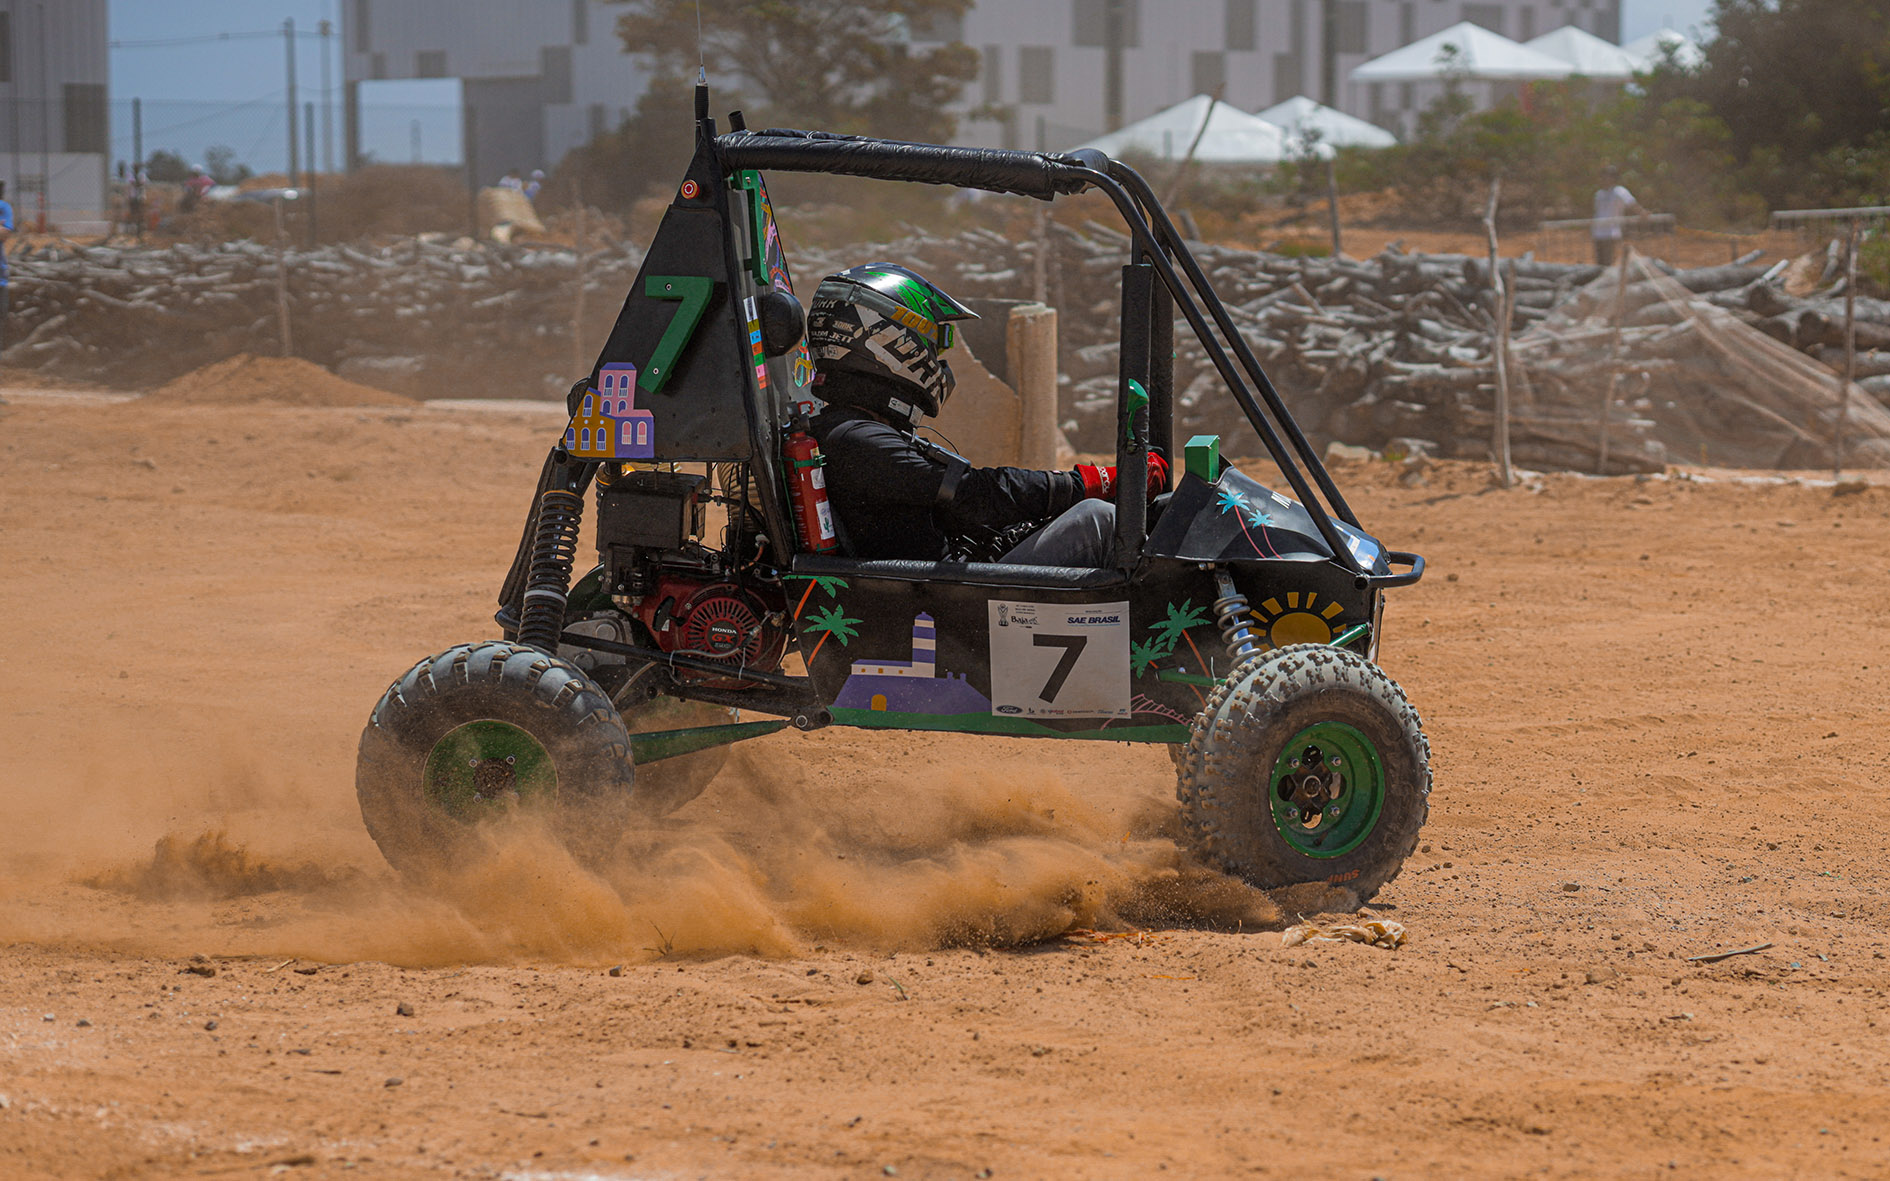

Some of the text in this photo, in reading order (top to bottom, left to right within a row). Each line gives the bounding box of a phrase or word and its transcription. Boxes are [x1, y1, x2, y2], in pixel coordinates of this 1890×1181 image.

[638, 275, 714, 394] 7
[1098, 466, 1111, 494] parco
[1067, 615, 1120, 624] SAE BRASIL
[711, 633, 736, 644] GX
[1033, 633, 1088, 704] 7
